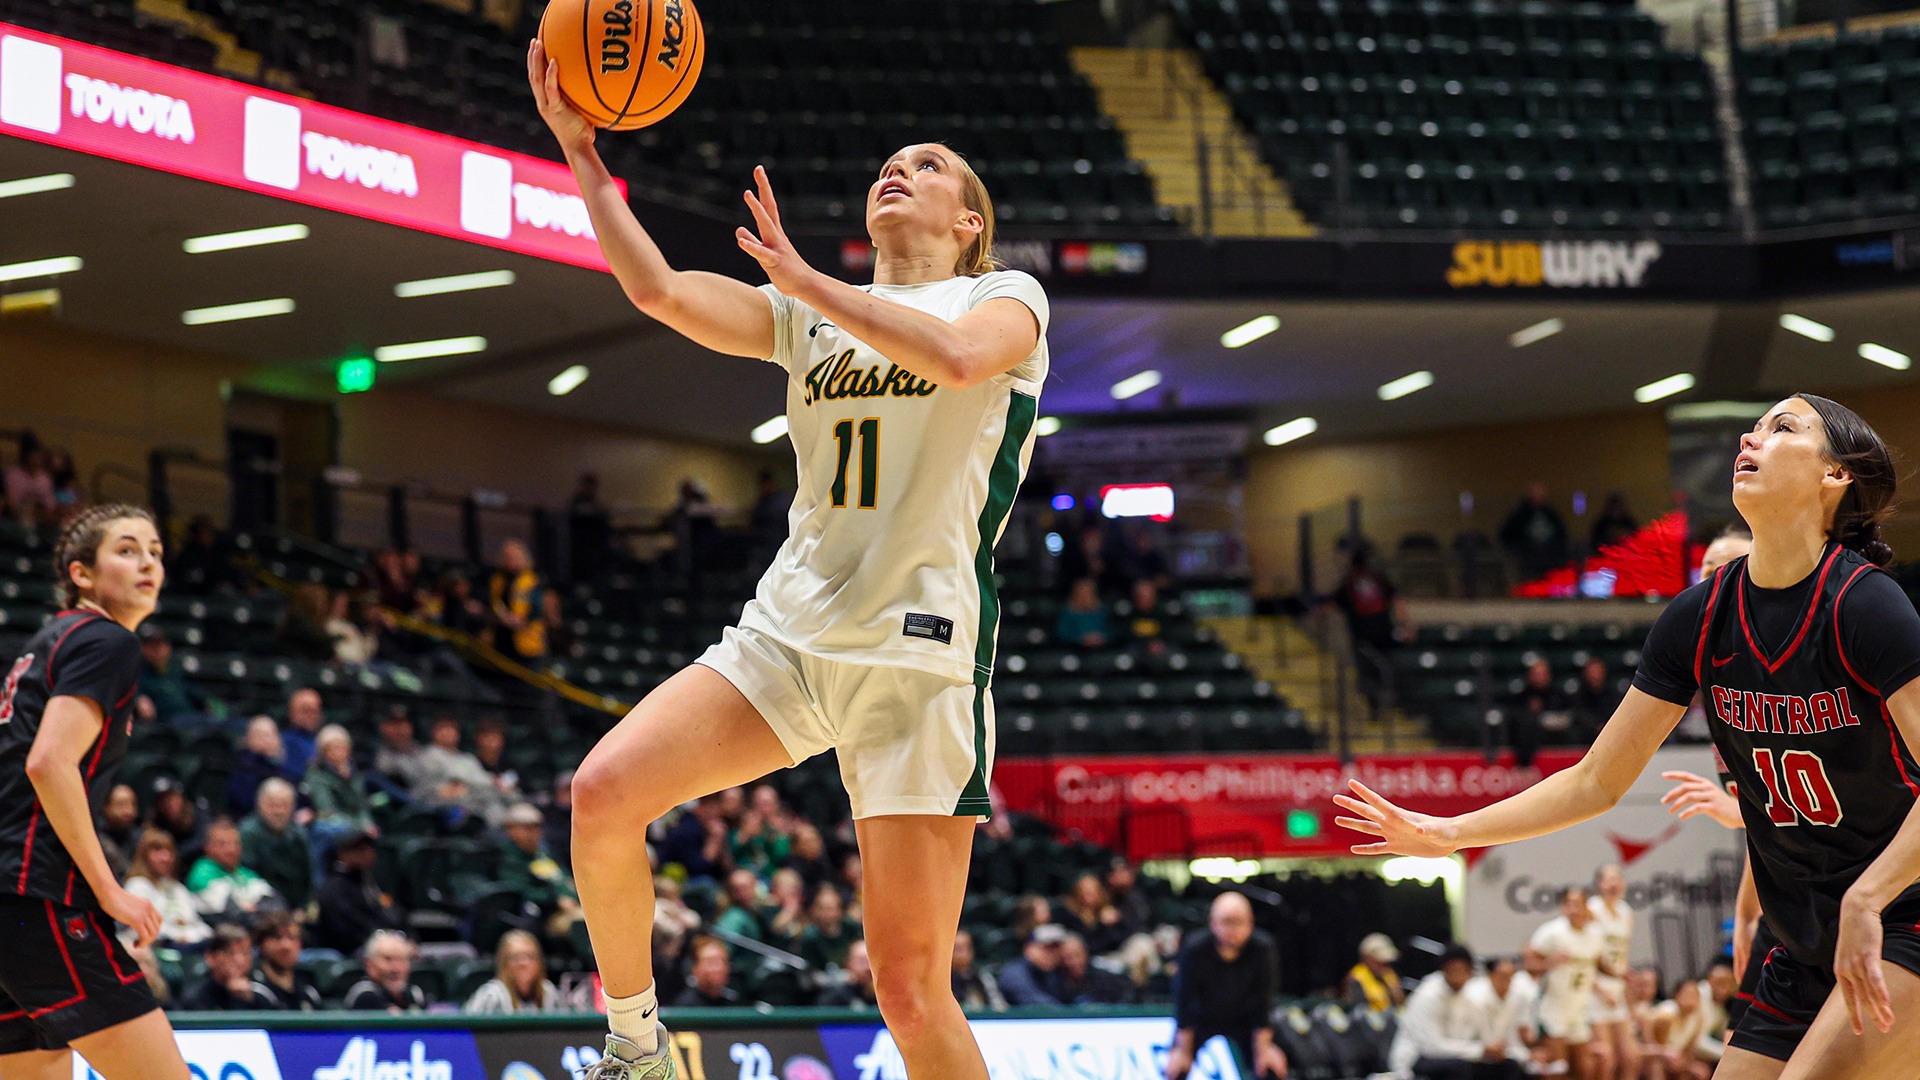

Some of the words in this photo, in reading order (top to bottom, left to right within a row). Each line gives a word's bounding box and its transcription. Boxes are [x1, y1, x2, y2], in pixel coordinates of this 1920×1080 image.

[656, 0, 684, 72] NCA
[65, 72, 196, 144] TOYOTA
[303, 130, 418, 198] TOYOTA
[513, 181, 598, 241] TOYO
[1446, 240, 1662, 288] SUBWAY
[805, 348, 942, 407] Alaska
[829, 416, 881, 510] 11
[939, 624, 948, 636] M
[1711, 685, 1861, 735] CENTRAL
[1752, 747, 1844, 828] 10
